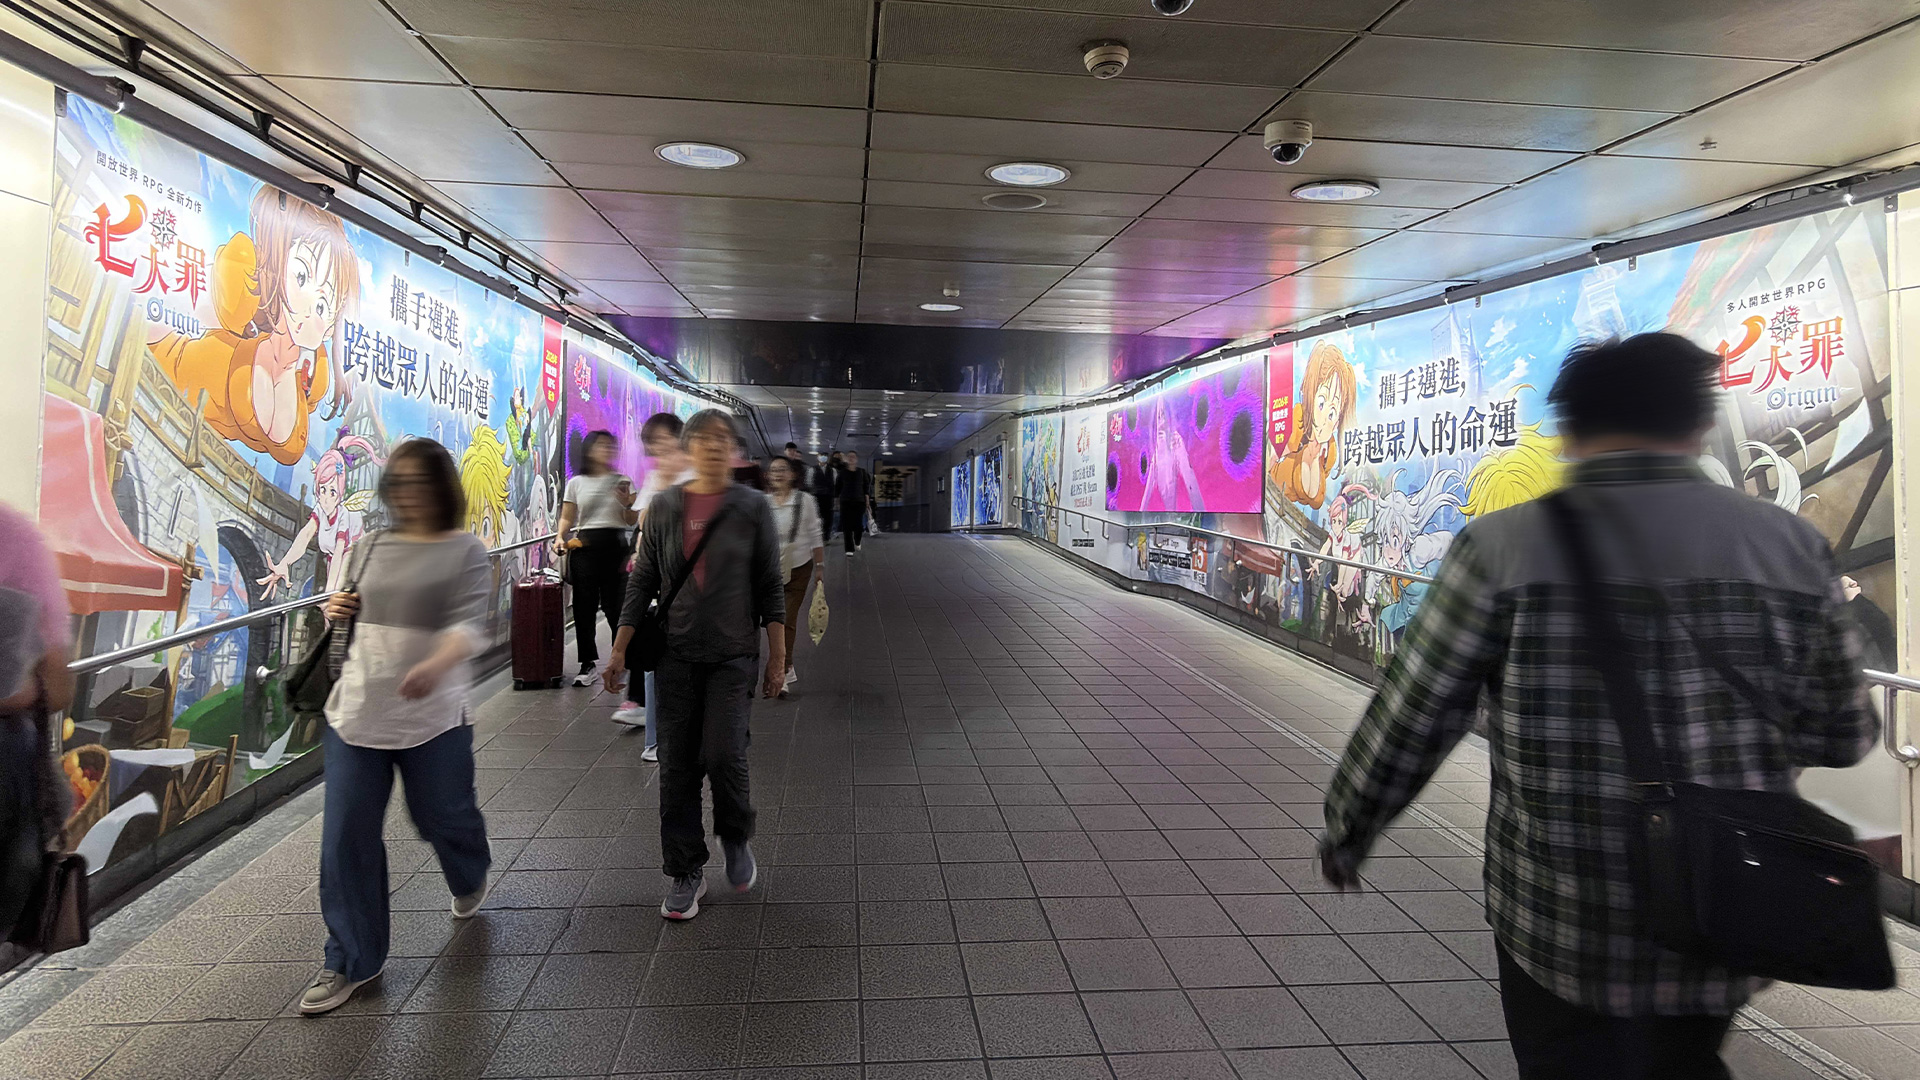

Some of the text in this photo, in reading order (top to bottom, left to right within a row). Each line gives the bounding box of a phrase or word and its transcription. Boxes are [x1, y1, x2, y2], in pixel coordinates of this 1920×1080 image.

[96, 150, 202, 215] 開放世界 RPG 全新力作
[83, 194, 207, 311] 七大罪
[146, 296, 201, 338] Origin
[1726, 278, 1826, 314] 多人開放世界RPG
[343, 318, 489, 420] 跨越眾人的命運
[1766, 386, 1838, 411] Origin
[1274, 421, 1286, 433] RPG
[1343, 397, 1518, 468] 跨越眾人的命運
